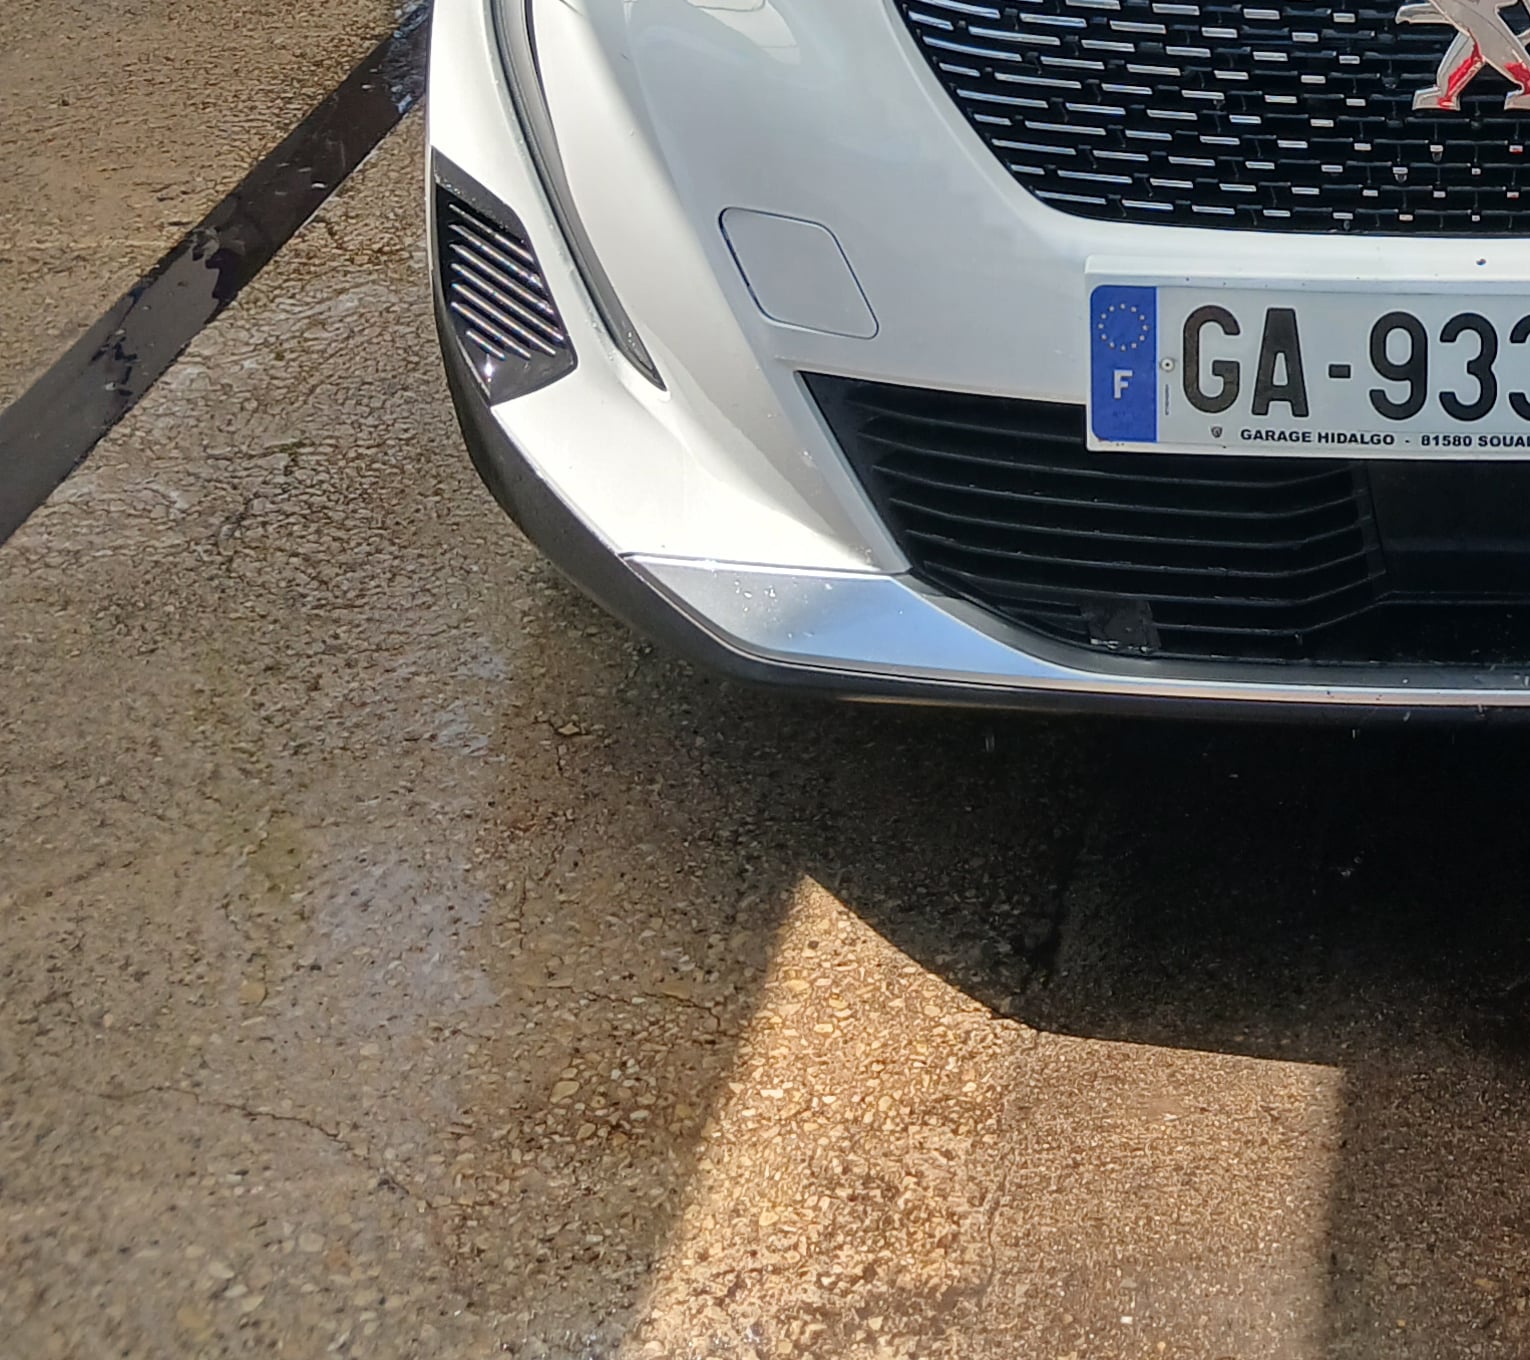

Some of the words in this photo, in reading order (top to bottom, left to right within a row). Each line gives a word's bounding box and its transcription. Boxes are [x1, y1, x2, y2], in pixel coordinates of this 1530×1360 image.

[1113, 369, 1133, 400] F
[1240, 429, 1312, 444] GARAGE
[1317, 432, 1395, 446] HIDALGO
[1421, 435, 1472, 447] 81580
